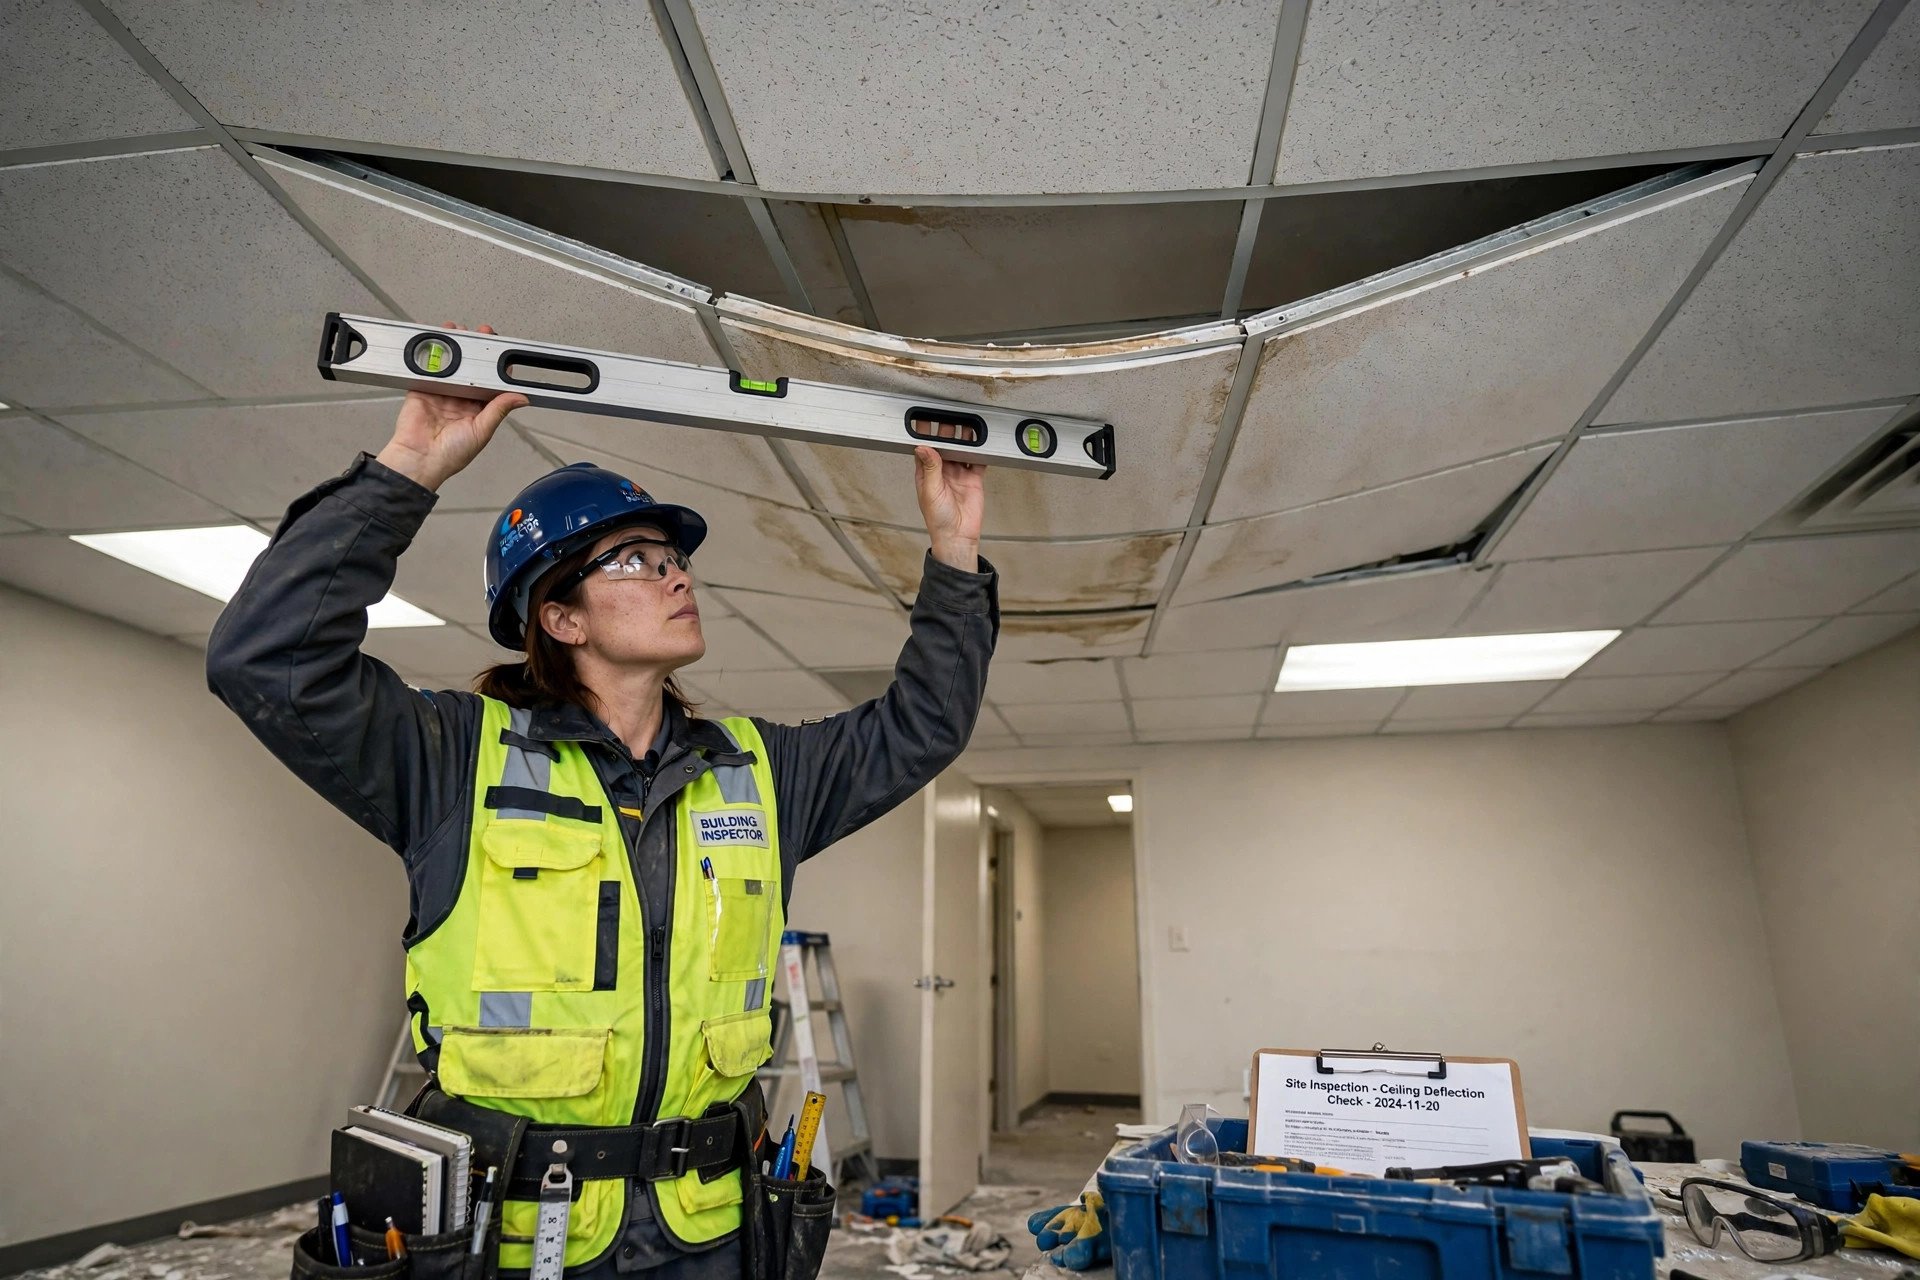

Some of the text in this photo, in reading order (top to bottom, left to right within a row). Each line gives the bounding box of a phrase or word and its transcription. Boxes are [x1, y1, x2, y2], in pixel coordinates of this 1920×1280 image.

[700, 815, 758, 829] BUILDING
[701, 828, 764, 842] INSPECTOR
[1285, 1078, 1307, 1089] Site
[1309, 1079, 1369, 1094] Inspection
[1379, 1083, 1421, 1098] Ceiling
[1423, 1085, 1485, 1099] Deflection
[1327, 1094, 1363, 1106] Check
[1374, 1096, 1440, 1112] 2024-11-20
